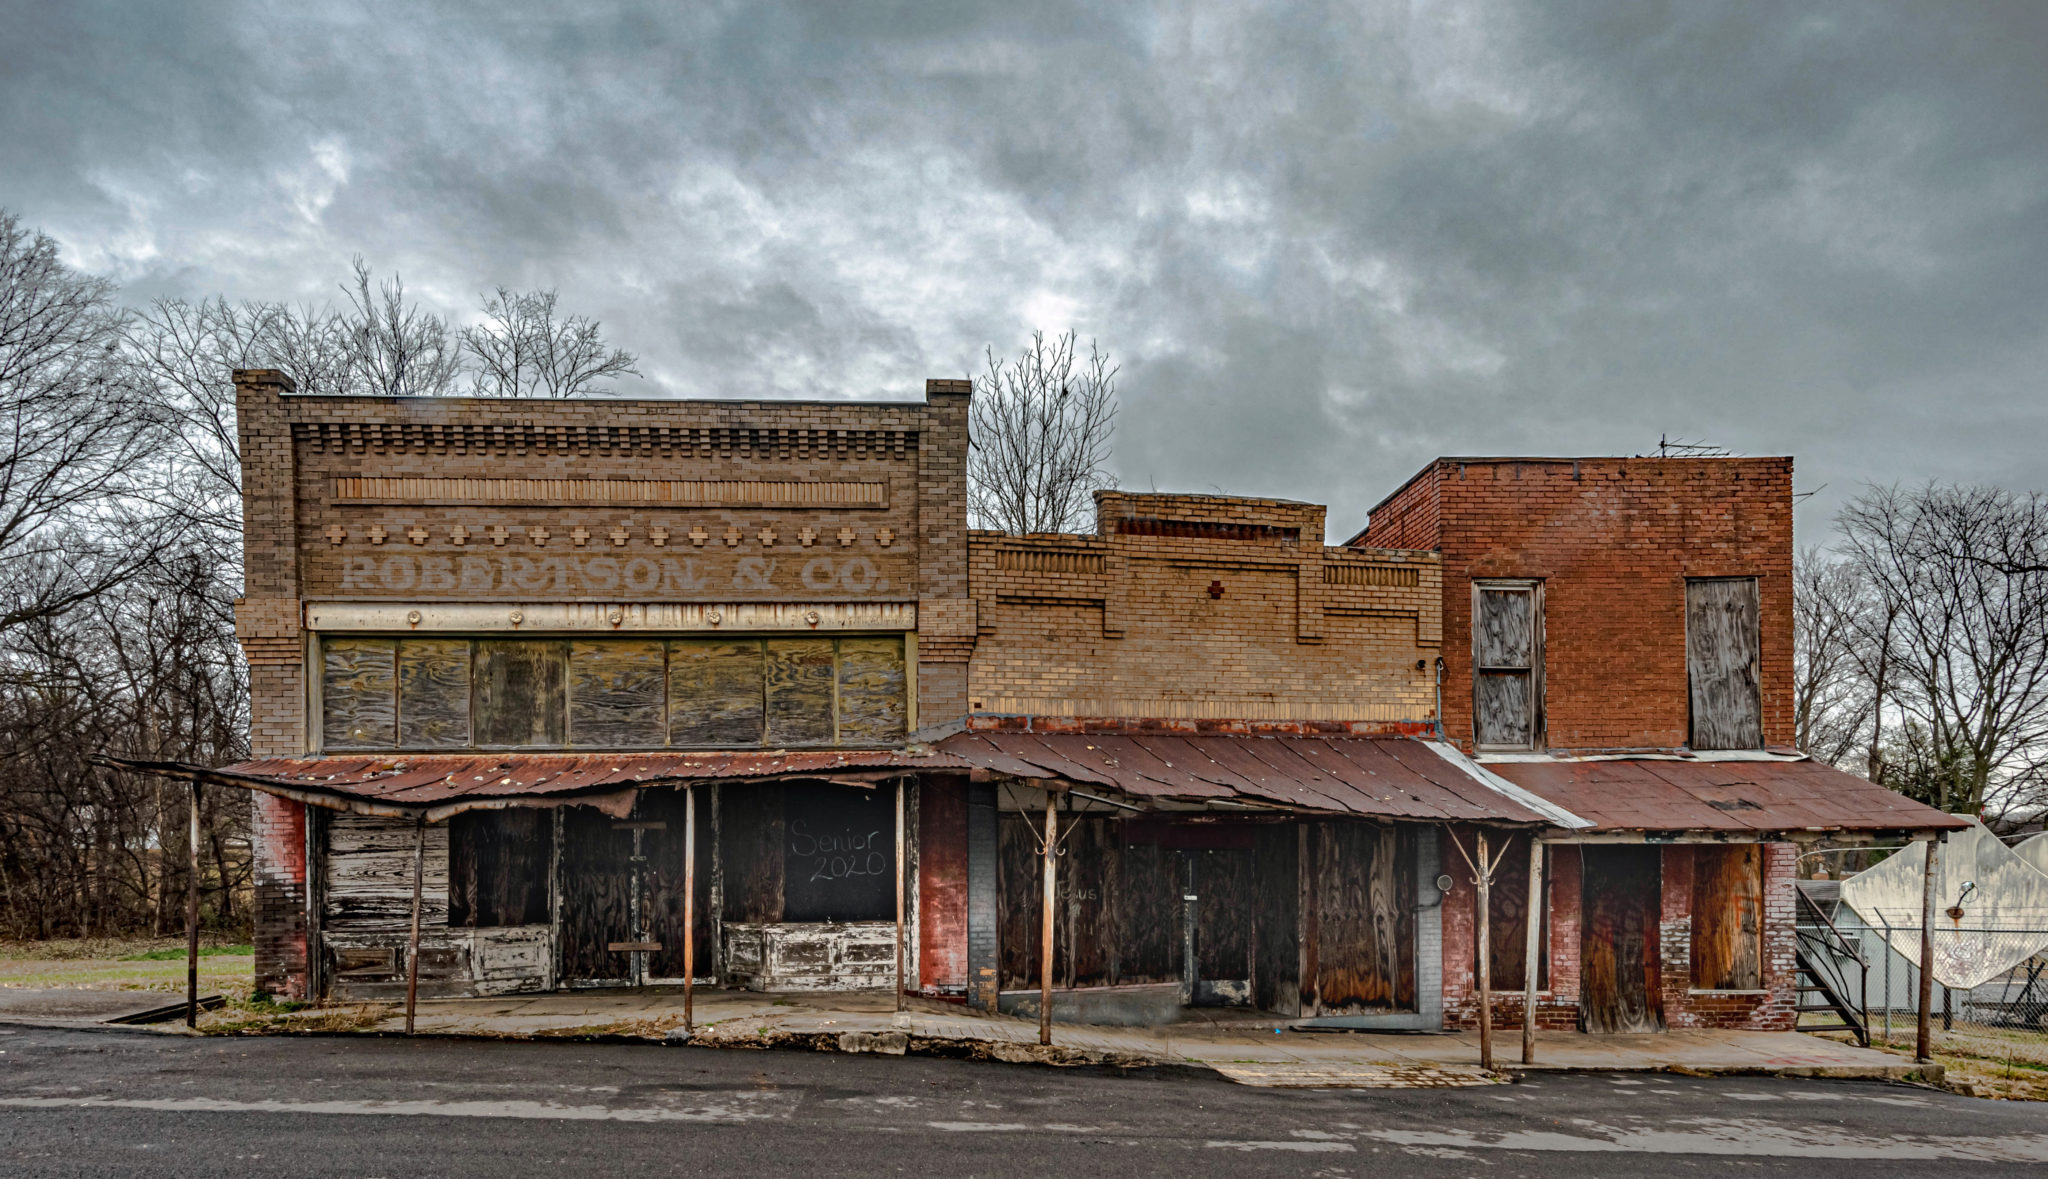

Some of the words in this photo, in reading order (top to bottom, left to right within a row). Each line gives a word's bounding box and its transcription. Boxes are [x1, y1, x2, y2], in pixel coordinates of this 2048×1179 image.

[338, 556, 707, 591] ROBERTSON
[732, 556, 779, 591] &
[801, 556, 889, 592] CO.
[791, 818, 880, 857] Senior
[809, 851, 886, 883] 2020
[1055, 880, 1097, 901] Jeus
